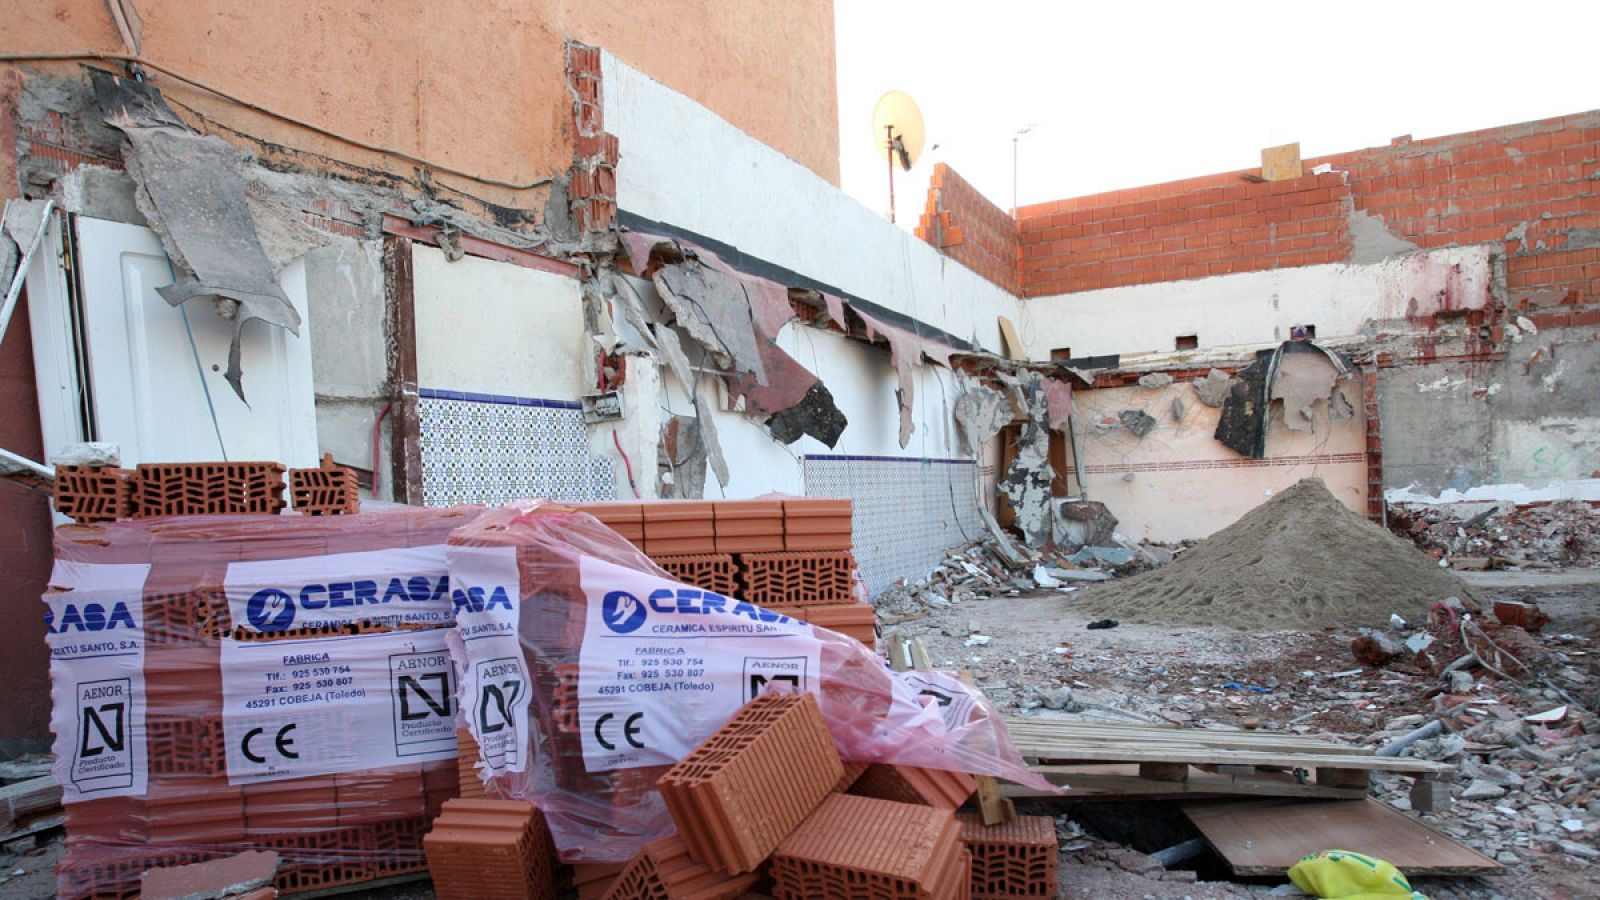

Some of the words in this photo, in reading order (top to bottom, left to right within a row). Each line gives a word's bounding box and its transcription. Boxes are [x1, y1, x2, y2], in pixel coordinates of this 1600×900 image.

[652, 624, 706, 633] CERAMICA
[709, 623, 753, 633] ESPIRITU
[635, 647, 686, 656] FABRICA
[283, 652, 330, 665] FABRICA
[398, 655, 446, 669] AENOR
[641, 659, 660, 667] 925
[663, 659, 682, 667] 530
[752, 661, 799, 670] AENOR
[292, 669, 310, 679] 925
[313, 667, 330, 676] 530
[334, 665, 351, 674] 754
[616, 671, 637, 680] Fax:
[641, 669, 660, 679] 925
[665, 668, 684, 678] 530
[687, 668, 705, 678] 807
[266, 685, 288, 694] Fax:
[292, 682, 311, 691] 925
[317, 679, 333, 688] 530
[336, 677, 353, 685] 807
[598, 686, 625, 696] 45291
[628, 681, 671, 694] COBEJA
[674, 681, 715, 693] (Toledo)
[83, 685, 123, 700] AENOR
[245, 698, 276, 709] 45291
[279, 693, 322, 706] COBEJA
[325, 688, 366, 702] (Toledo)
[401, 721, 442, 730] Producto
[402, 726, 453, 737] Certificado
